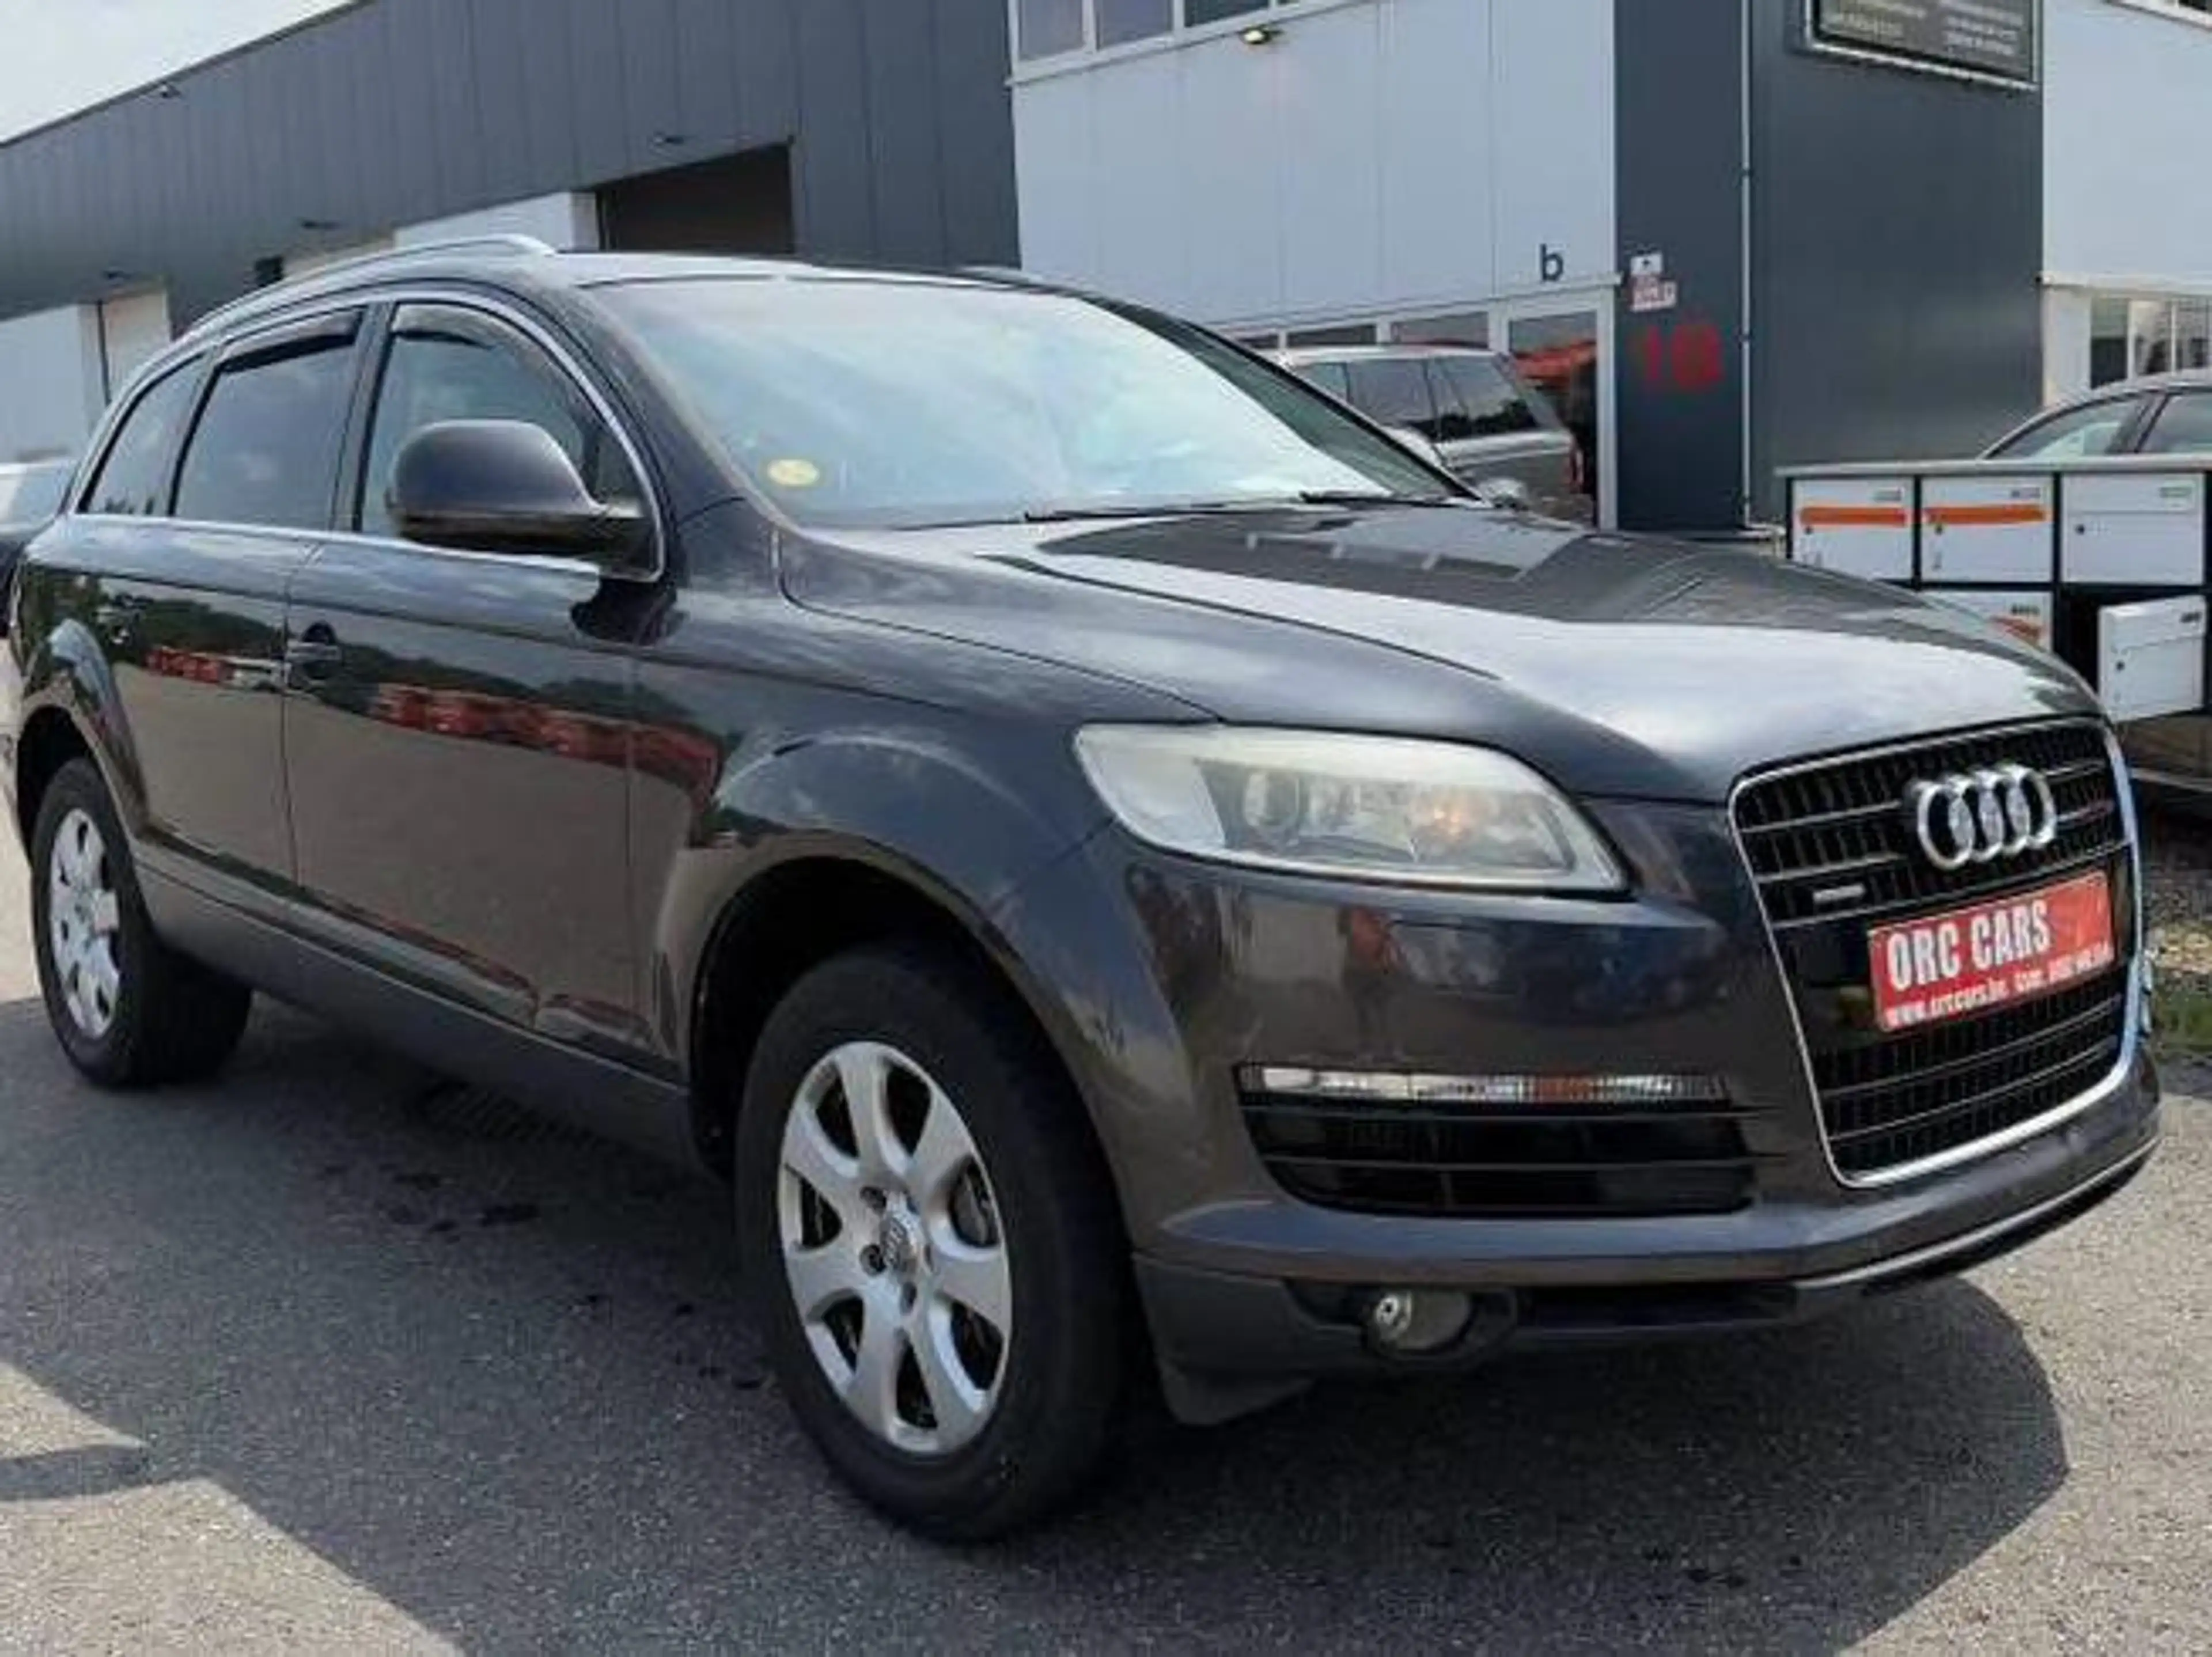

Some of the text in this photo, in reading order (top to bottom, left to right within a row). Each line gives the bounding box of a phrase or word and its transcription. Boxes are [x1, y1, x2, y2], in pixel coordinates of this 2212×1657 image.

[1540, 243, 1563, 282] b
[1887, 922, 1961, 992] ORC
[1971, 901, 2051, 970] CARS
